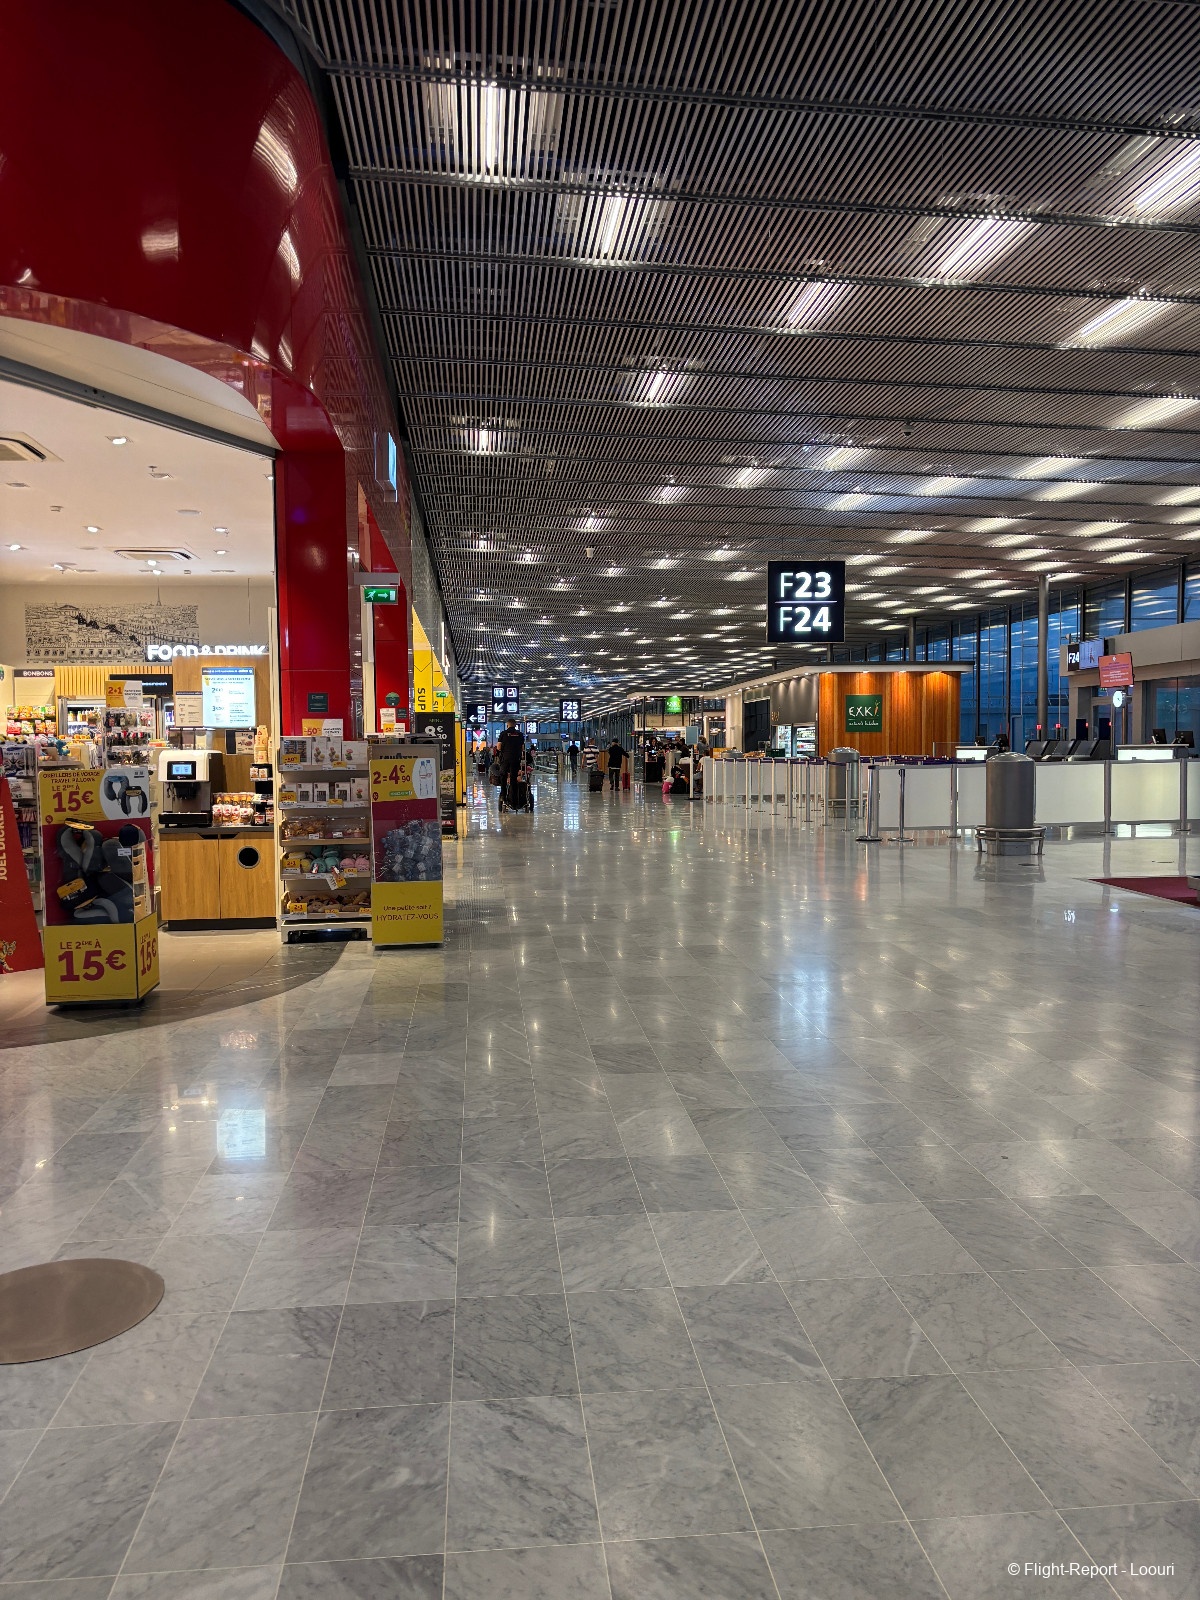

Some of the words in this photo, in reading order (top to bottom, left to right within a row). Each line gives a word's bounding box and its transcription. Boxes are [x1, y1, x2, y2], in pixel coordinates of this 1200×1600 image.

[780, 571, 832, 598] F23
[779, 606, 832, 632] F24
[147, 644, 199, 660] FOOD
[200, 645, 212, 656] &
[214, 644, 266, 656] DRINK
[1068, 652, 1080, 664] F24
[107, 686, 123, 695] 2+1
[562, 701, 579, 710] F25
[562, 710, 579, 719] F26
[52, 790, 94, 813] 15€
[397, 904, 416, 912] petite
[376, 913, 439, 922] HYDRATEZ-VOUS
[60, 941, 72, 950] LE
[94, 938, 102, 949] À
[140, 937, 157, 977] 15€
[57, 949, 127, 982] 15€
